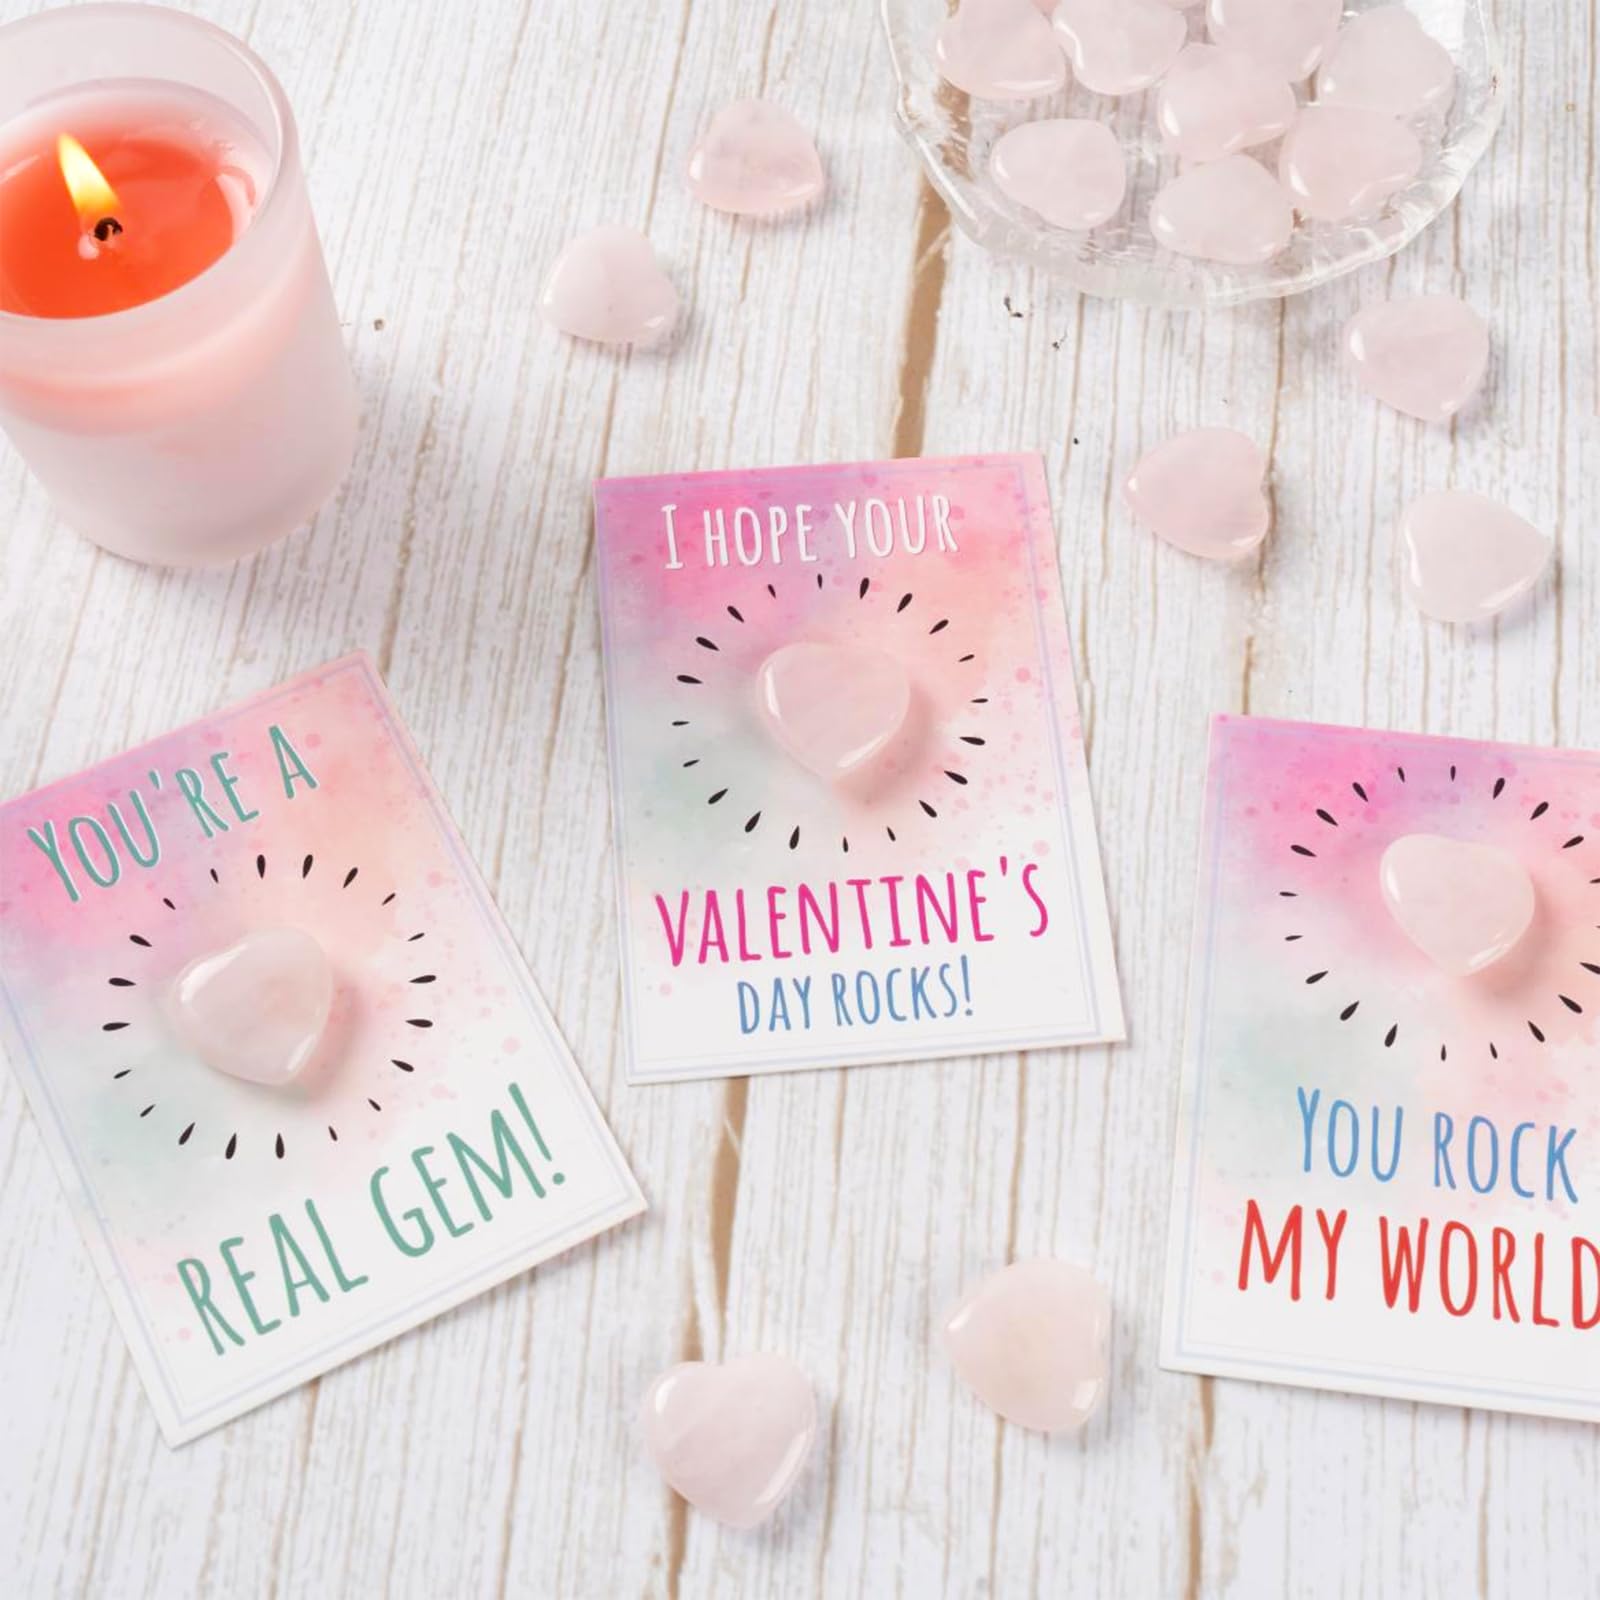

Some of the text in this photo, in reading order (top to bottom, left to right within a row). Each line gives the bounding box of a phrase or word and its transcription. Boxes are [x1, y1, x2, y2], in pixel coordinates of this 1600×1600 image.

[661, 494, 960, 569] I HOPE YOUR
[26, 724, 318, 904] YOU'RE A
[655, 855, 1050, 968] VALENTINE'S
[736, 954, 975, 1035] DAY ROCKS!
[1297, 1086, 1579, 1204] YOU ROCK
[176, 1082, 566, 1357] REAL GEM!
[1238, 1198, 1600, 1330] MY WORLD
